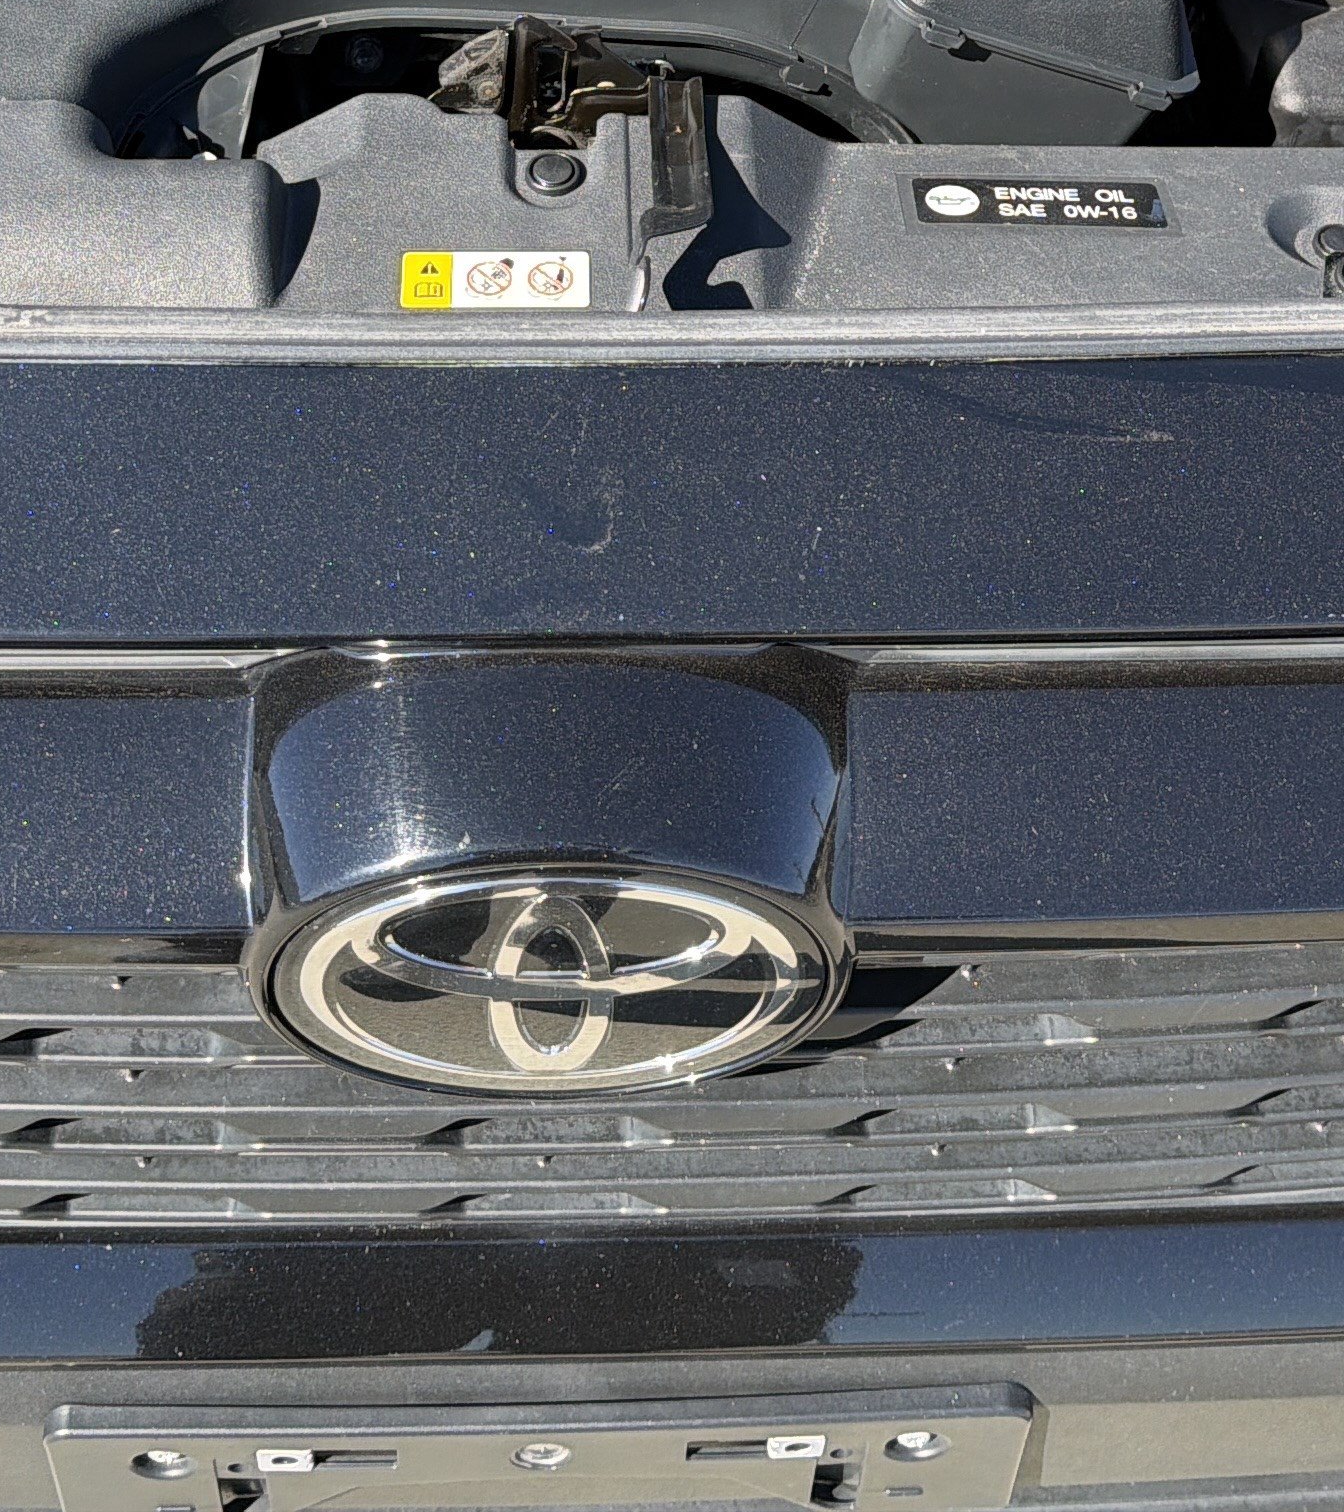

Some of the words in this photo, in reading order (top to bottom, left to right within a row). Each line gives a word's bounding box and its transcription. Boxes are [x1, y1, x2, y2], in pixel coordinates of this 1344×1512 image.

[993, 186, 1080, 202] ENGINE
[1094, 188, 1135, 204] OIL
[998, 203, 1047, 218] SAE
[1063, 205, 1138, 220] 0W-16
